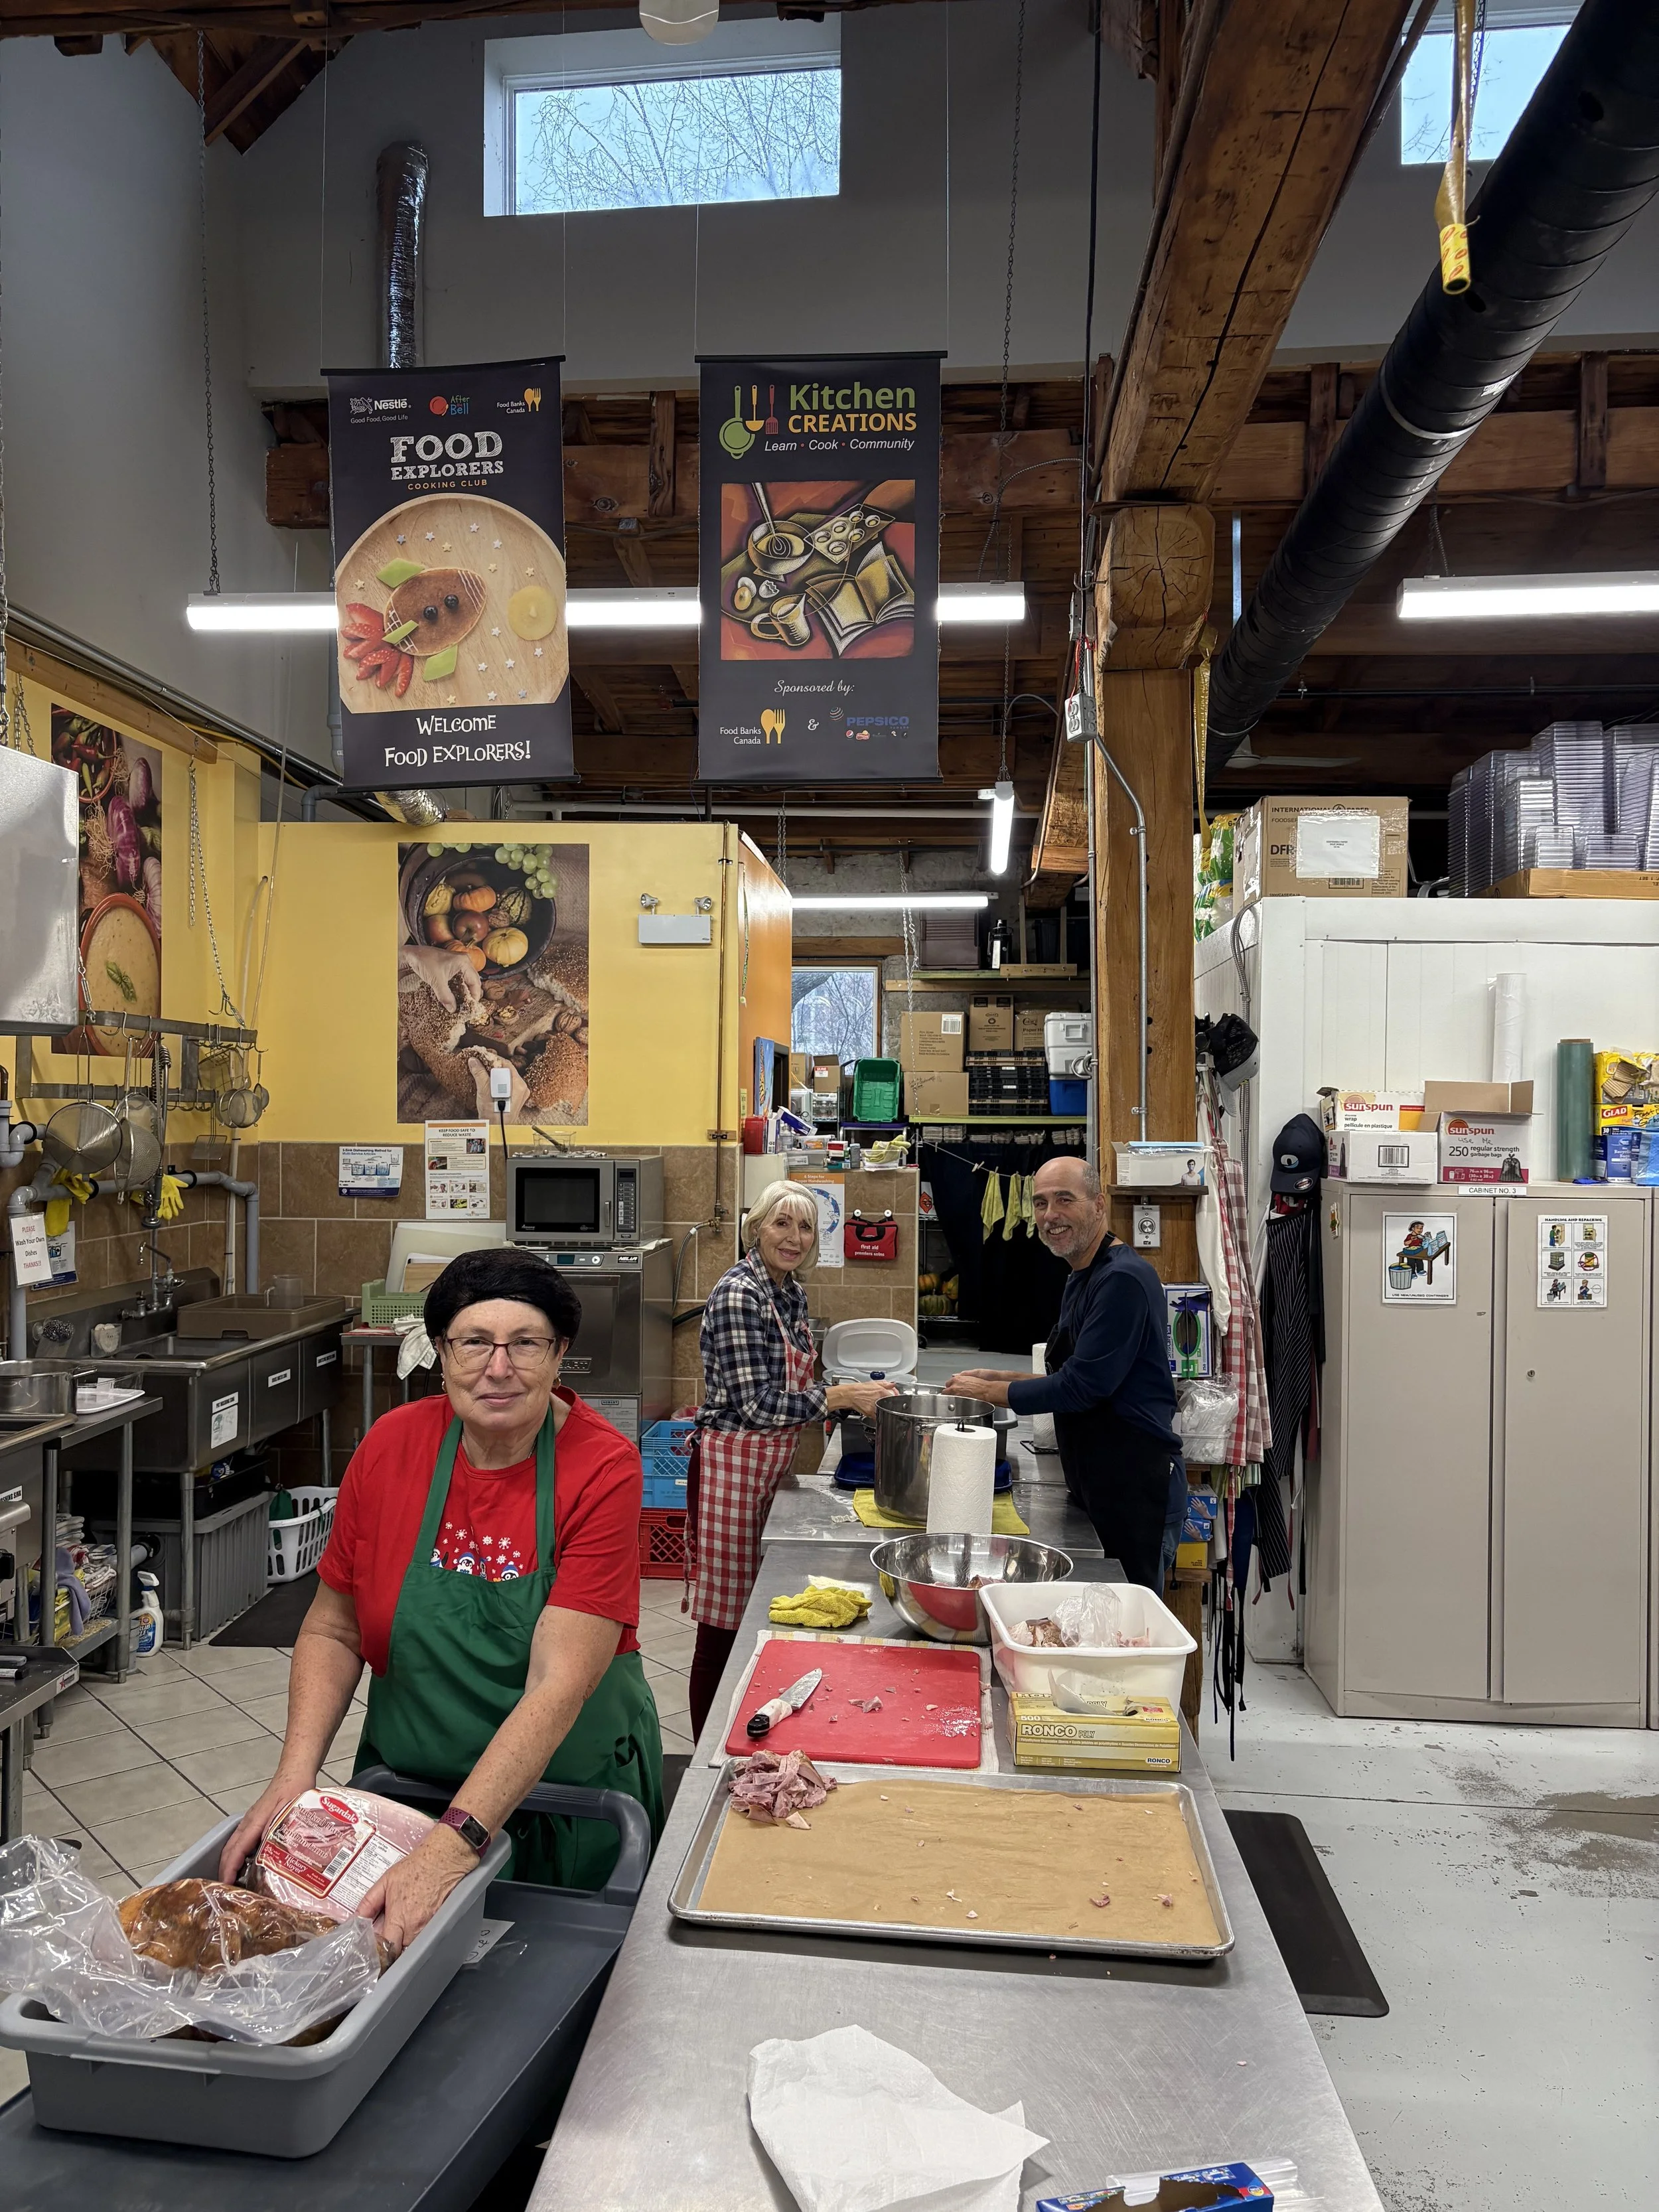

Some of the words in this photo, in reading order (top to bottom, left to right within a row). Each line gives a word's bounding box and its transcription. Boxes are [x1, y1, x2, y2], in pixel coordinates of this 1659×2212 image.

[451, 395, 470, 404] After
[789, 381, 916, 411] Kitchen
[451, 402, 469, 415] Bell
[788, 412, 917, 433] CREATIONS
[390, 431, 504, 464] FOOD
[764, 440, 798, 452] Learn
[808, 439, 839, 451] Cook
[849, 438, 915, 451] Community
[390, 460, 504, 480] EXPLORERS
[407, 480, 456, 490] COOKING
[461, 479, 488, 488] CLUB
[774, 679, 835, 696] Sponsored
[837, 679, 855, 696] by:
[807, 719, 820, 731] &
[847, 715, 910, 727] PEPSICO
[384, 747, 427, 767] FOOD
[433, 740, 531, 764] EXPLORERS!
[1344, 1102, 1394, 1112] sunspun
[1603, 1107, 1627, 1118] GLAD
[1449, 1127, 1495, 1136] sunspun
[1449, 1146, 1469, 1157] 250
[1021, 1724, 1077, 1737] RONCO
[297, 1803, 326, 1826] Smoked
[321, 1796, 357, 1824] Sugardale
[284, 1861, 304, 1874] Noyer
[285, 1854, 308, 1872] Hickory
